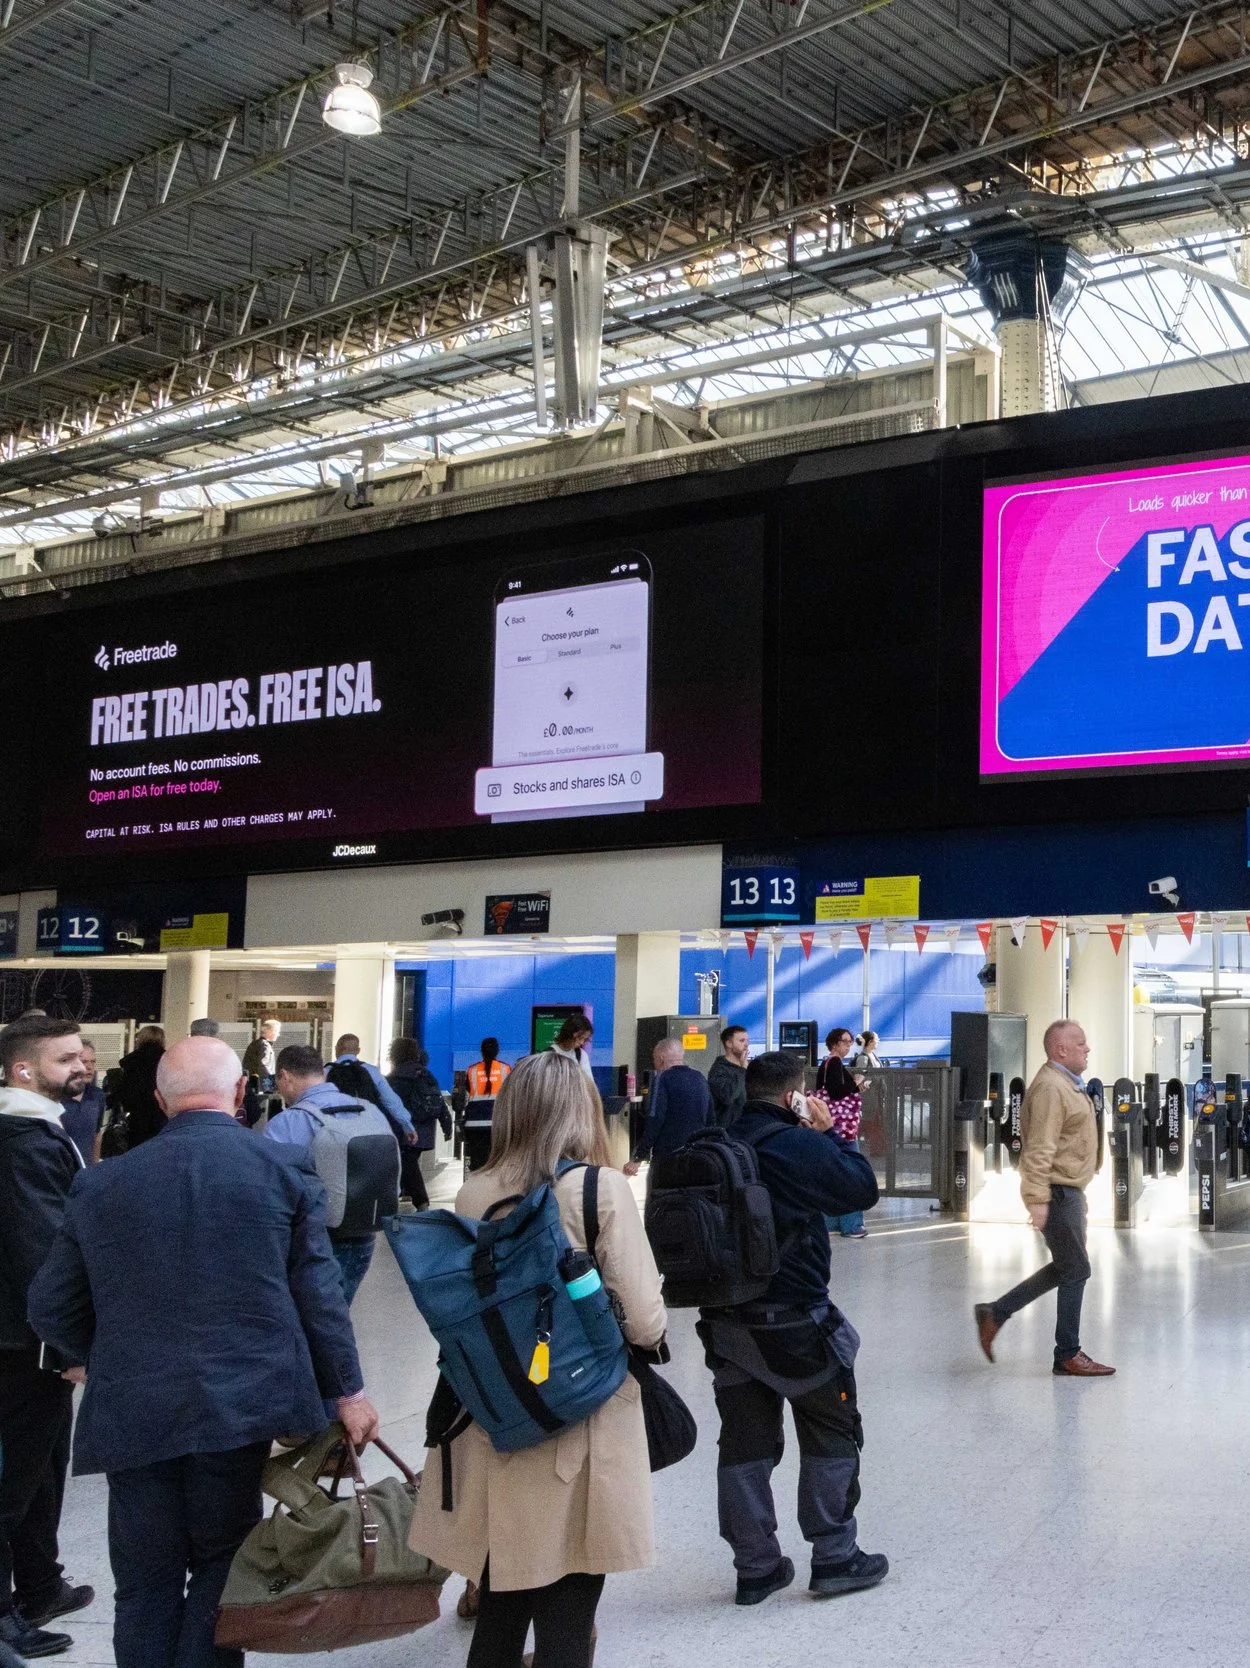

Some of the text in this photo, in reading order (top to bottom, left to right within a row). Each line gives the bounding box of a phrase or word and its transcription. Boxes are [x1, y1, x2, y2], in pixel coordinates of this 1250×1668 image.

[1129, 495, 1164, 512] Loads
[1171, 490, 1213, 512] quicker
[1220, 486, 1247, 501] than
[508, 580, 522, 590] 9:41
[512, 616, 526, 625] Back
[541, 627, 599, 642] Choose your plan
[114, 640, 177, 666] Freetrade
[517, 655, 532, 663] Basic
[558, 648, 581, 658] Standard
[90, 660, 382, 746] FREE TRADES. FREE ISA.
[90, 752, 261, 781] No account fees. No commissions.
[89, 778, 222, 804] Open an ISA for free today.
[513, 773, 626, 795] Stocks and shares ISA
[86, 809, 336, 840] CAPITAL AT RISK. ISA RULES AND OTHER CHARGES MAY APPLY.
[332, 844, 376, 857] JCDecaux
[730, 877, 760, 905] 13
[770, 877, 796, 905] 13
[528, 900, 548, 911] WiFi
[40, 917, 59, 939] 12
[68, 917, 99, 939] 12
[1202, 1174, 1210, 1210] PEPSI
